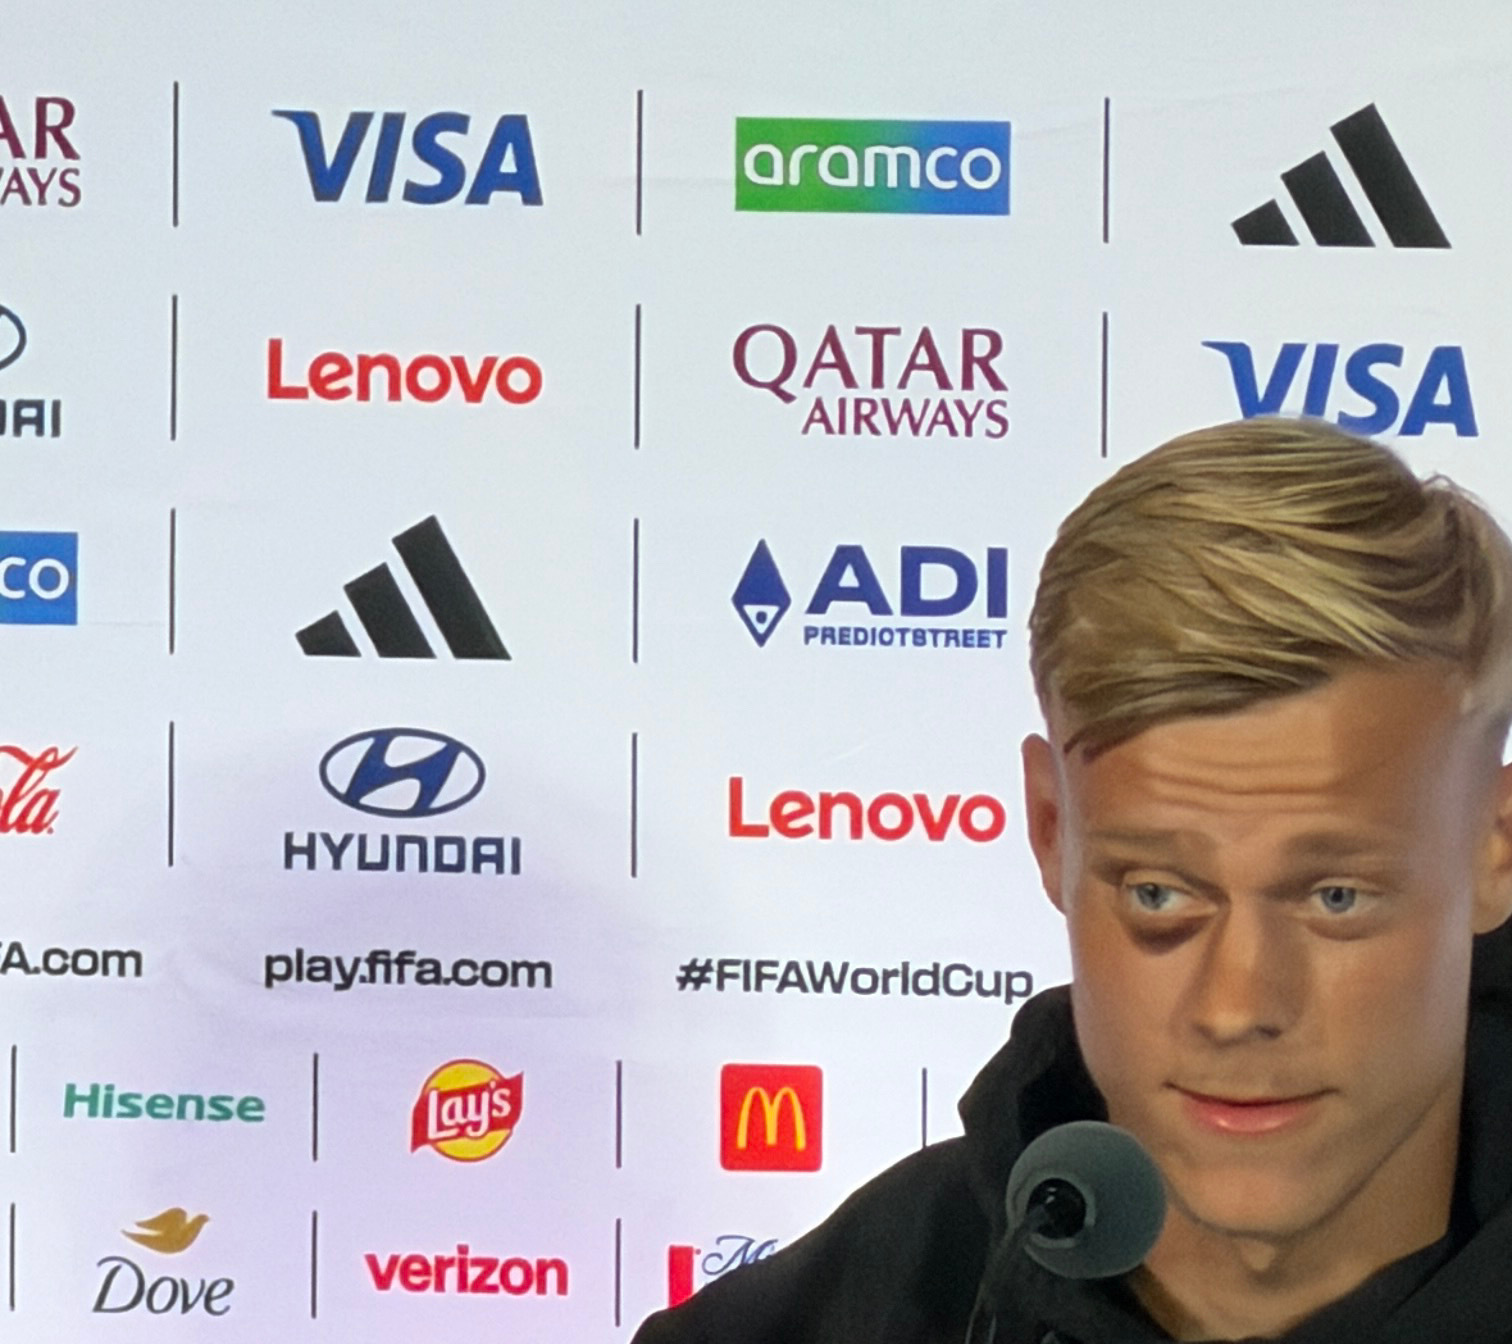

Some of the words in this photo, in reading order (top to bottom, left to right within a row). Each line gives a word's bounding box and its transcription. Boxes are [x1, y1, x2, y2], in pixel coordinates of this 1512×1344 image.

[271, 109, 544, 207] VISA
[743, 143, 1002, 190] aramco
[267, 338, 544, 405] Lenovo
[732, 324, 1009, 403] QATAR
[1201, 340, 1479, 437] VISA
[801, 398, 1009, 439] AIRWAYS
[805, 545, 1008, 618] ADI
[729, 777, 1006, 843] Lenovo
[284, 832, 522, 875] HYUNDAI
[264, 948, 553, 992] play.fifa.com
[676, 958, 1034, 1005] #FIFAWorldCup
[63, 1083, 266, 1122] Hisense
[427, 1082, 512, 1141] Lay's
[92, 1255, 235, 1316] Dove
[364, 1244, 569, 1296] verizon
